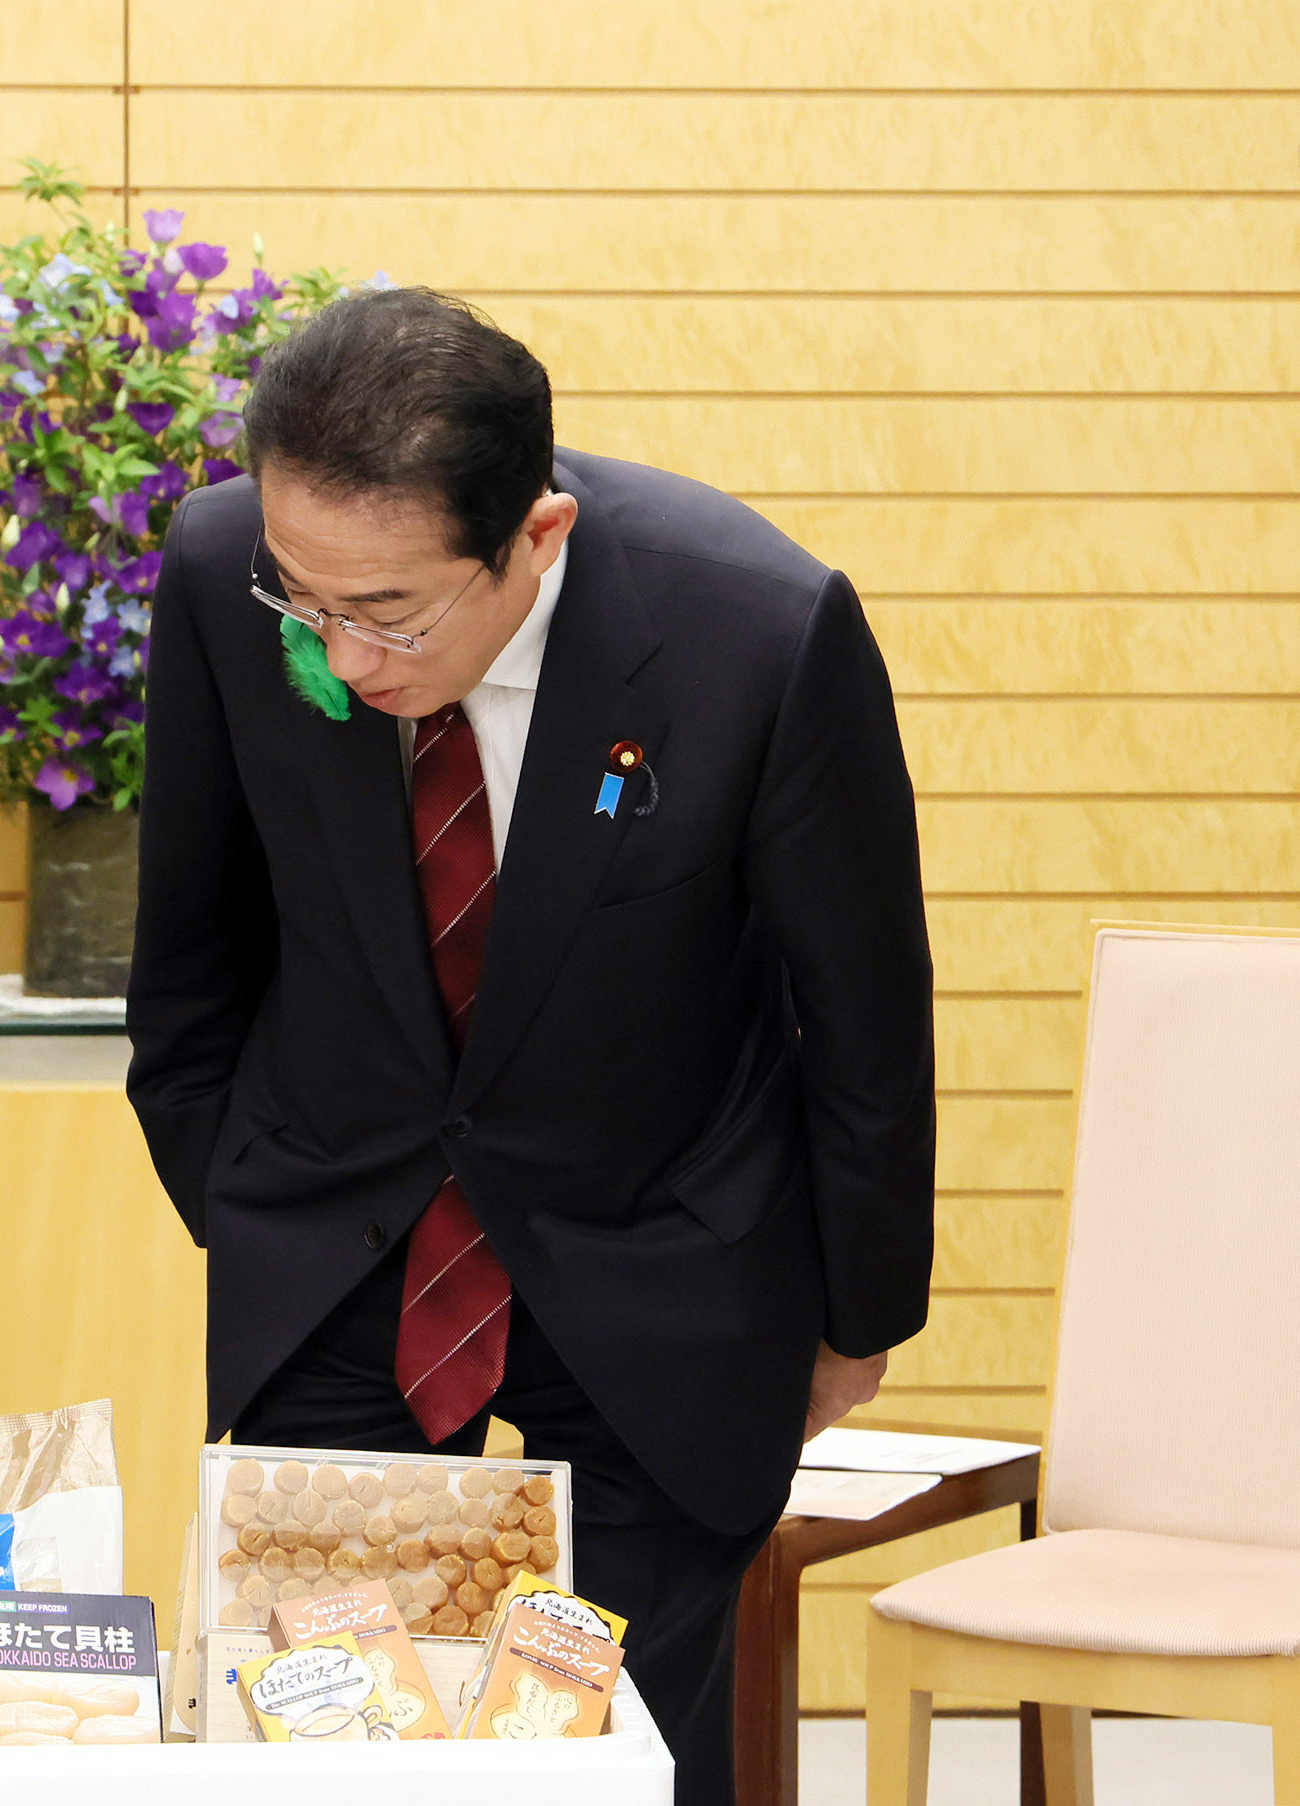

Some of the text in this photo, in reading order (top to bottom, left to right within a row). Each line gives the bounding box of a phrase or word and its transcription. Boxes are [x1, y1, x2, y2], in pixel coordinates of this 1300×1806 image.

[18, 1603, 68, 1613] KEEP FROZEN
[294, 1603, 388, 1639] こんぶのスープ
[54, 1651, 79, 1668] SEA
[80, 1653, 137, 1671] SCALLOP
[513, 1626, 611, 1677] こんぶのスープ
[258, 1656, 353, 1698] ほたてのスープ
